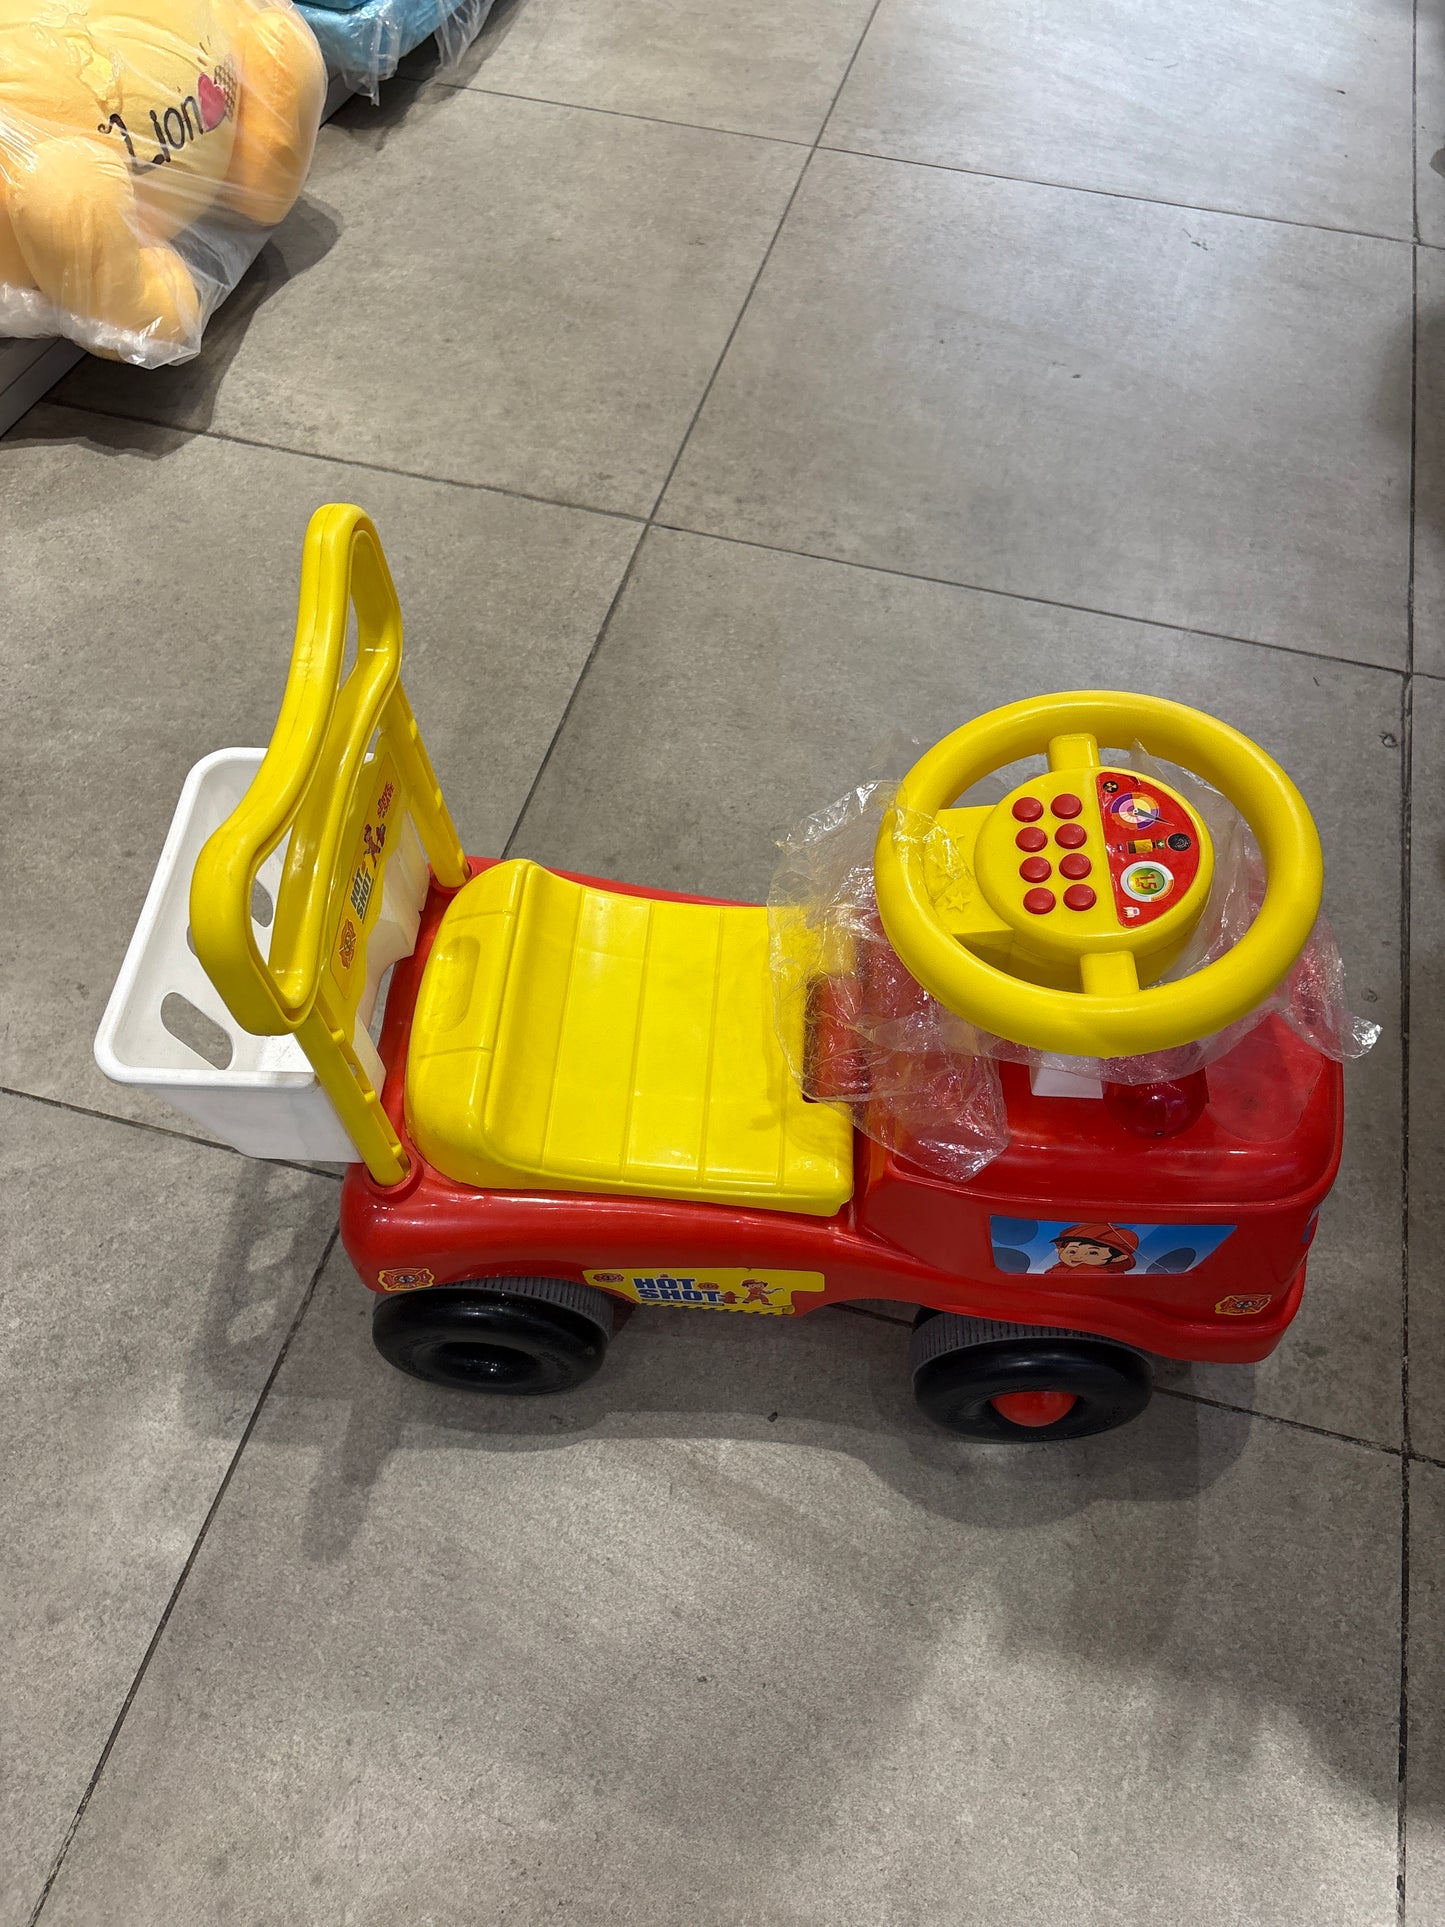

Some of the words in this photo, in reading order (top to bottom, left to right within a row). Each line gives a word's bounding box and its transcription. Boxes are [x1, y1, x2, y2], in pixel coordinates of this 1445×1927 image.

[97, 95, 204, 175] Lion
[350, 866, 363, 909] HOT
[356, 868, 371, 920] SHOT
[632, 1278, 696, 1290] HOT
[637, 1289, 721, 1302] SHOT
